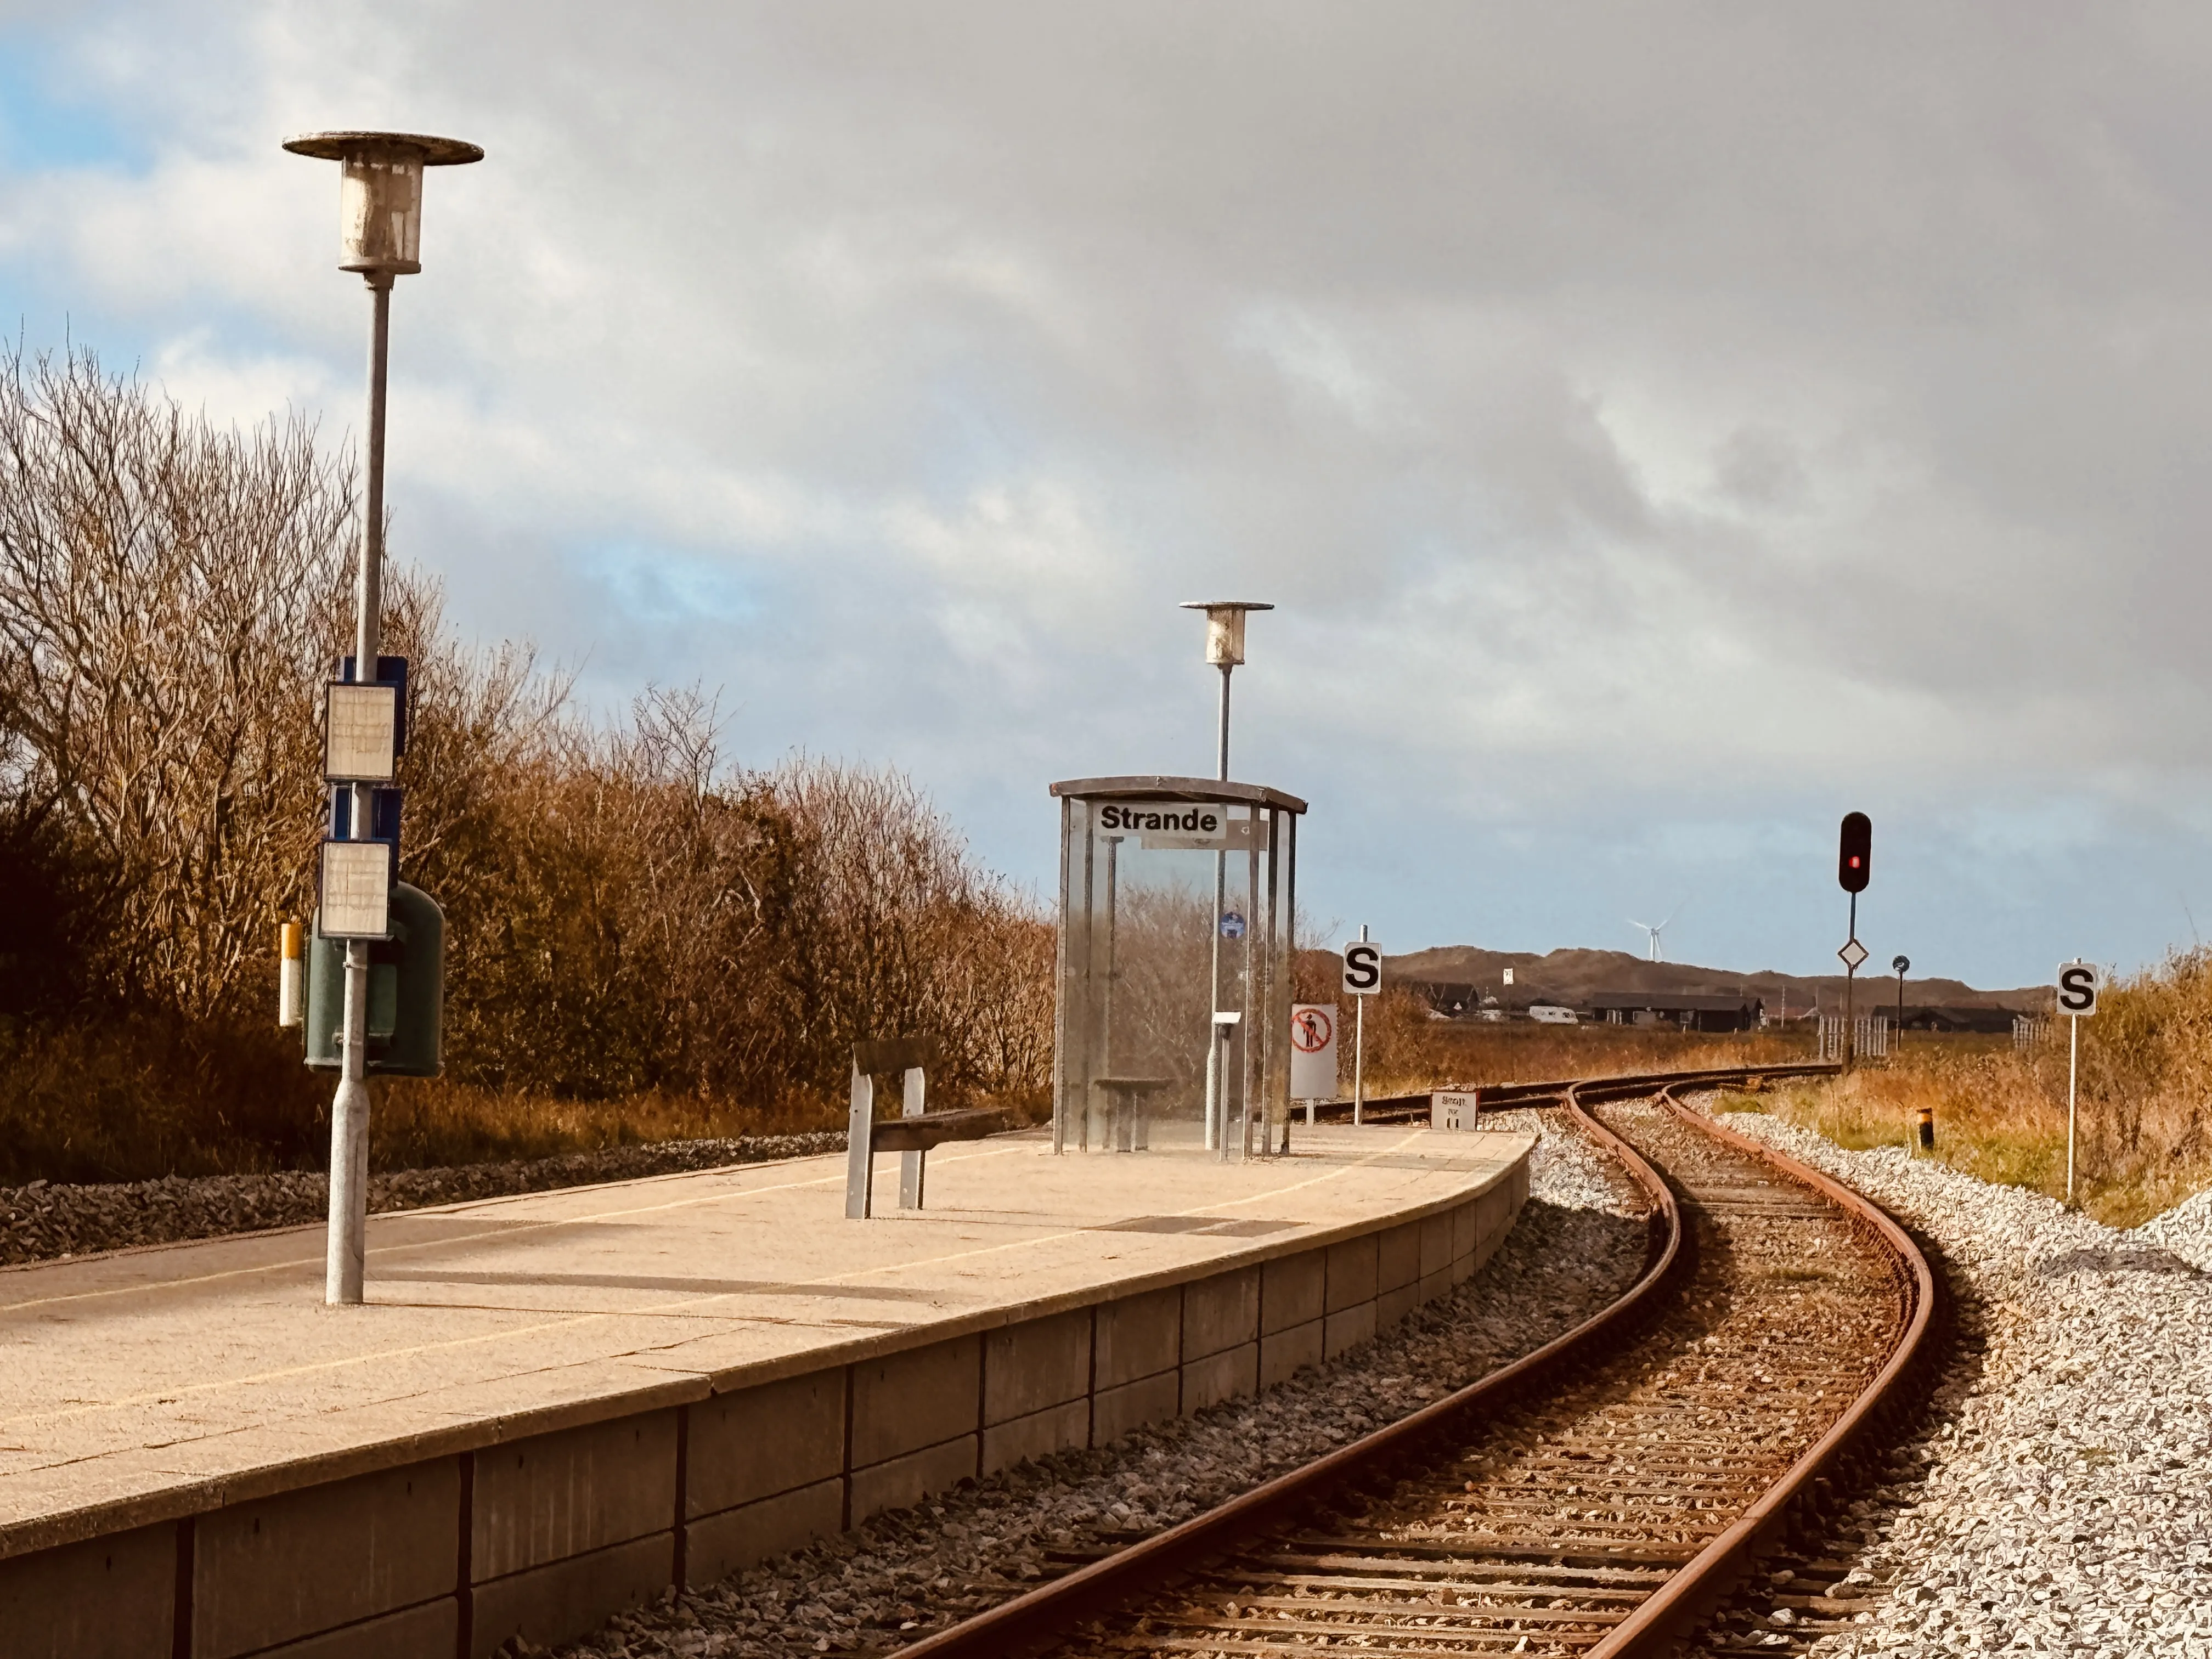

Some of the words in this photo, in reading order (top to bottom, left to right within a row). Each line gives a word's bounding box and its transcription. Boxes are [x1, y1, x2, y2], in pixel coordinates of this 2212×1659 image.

[1101, 805, 1218, 832] Strande
[1345, 947, 1379, 989] S
[2060, 968, 2094, 1010] S
